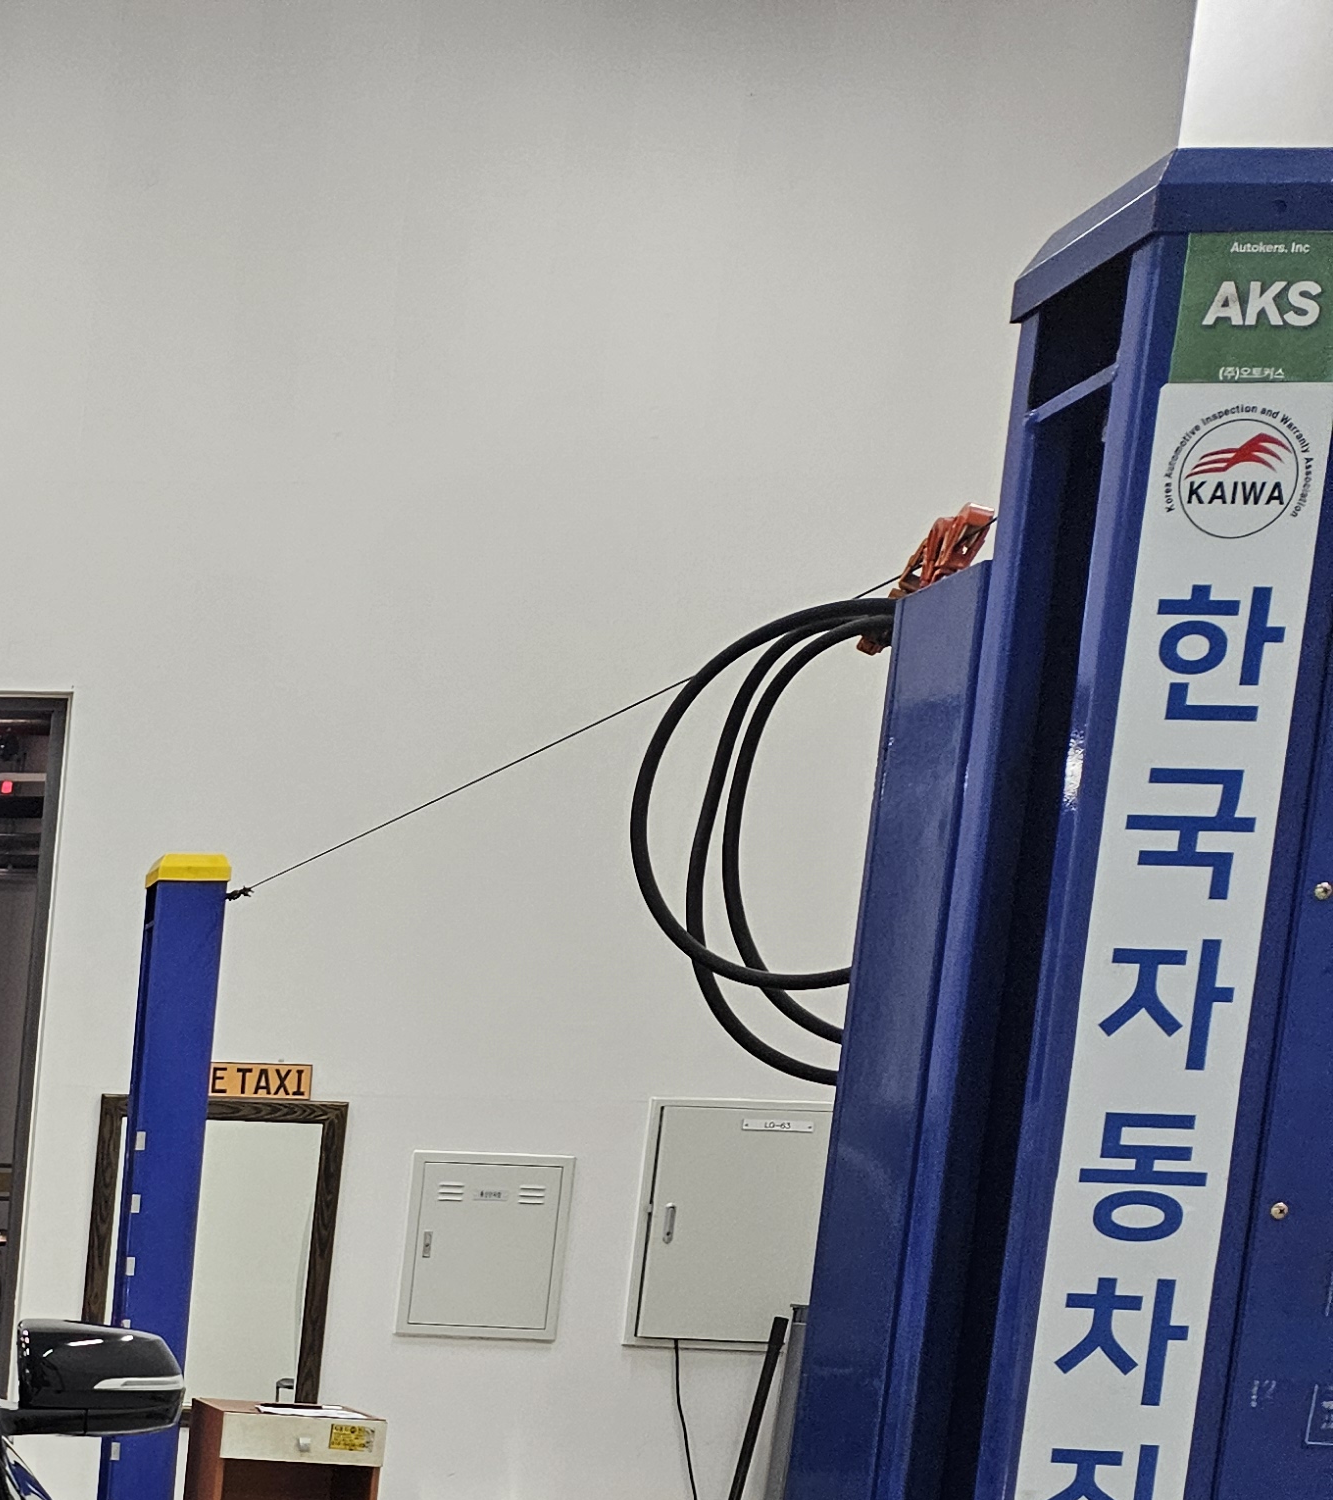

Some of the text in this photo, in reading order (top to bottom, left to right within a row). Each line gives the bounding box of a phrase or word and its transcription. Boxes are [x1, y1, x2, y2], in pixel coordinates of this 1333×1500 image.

[1291, 241, 1311, 253] Inc
[1201, 280, 1323, 327] AKS
[1201, 404, 1258, 426] Inspection
[1260, 407, 1280, 419] and
[1279, 413, 1311, 454] Warranty
[1164, 482, 1175, 513] Korea
[1186, 480, 1285, 506] KAIWA
[1289, 456, 1315, 519] Association
[236, 1067, 306, 1096] TAXI
